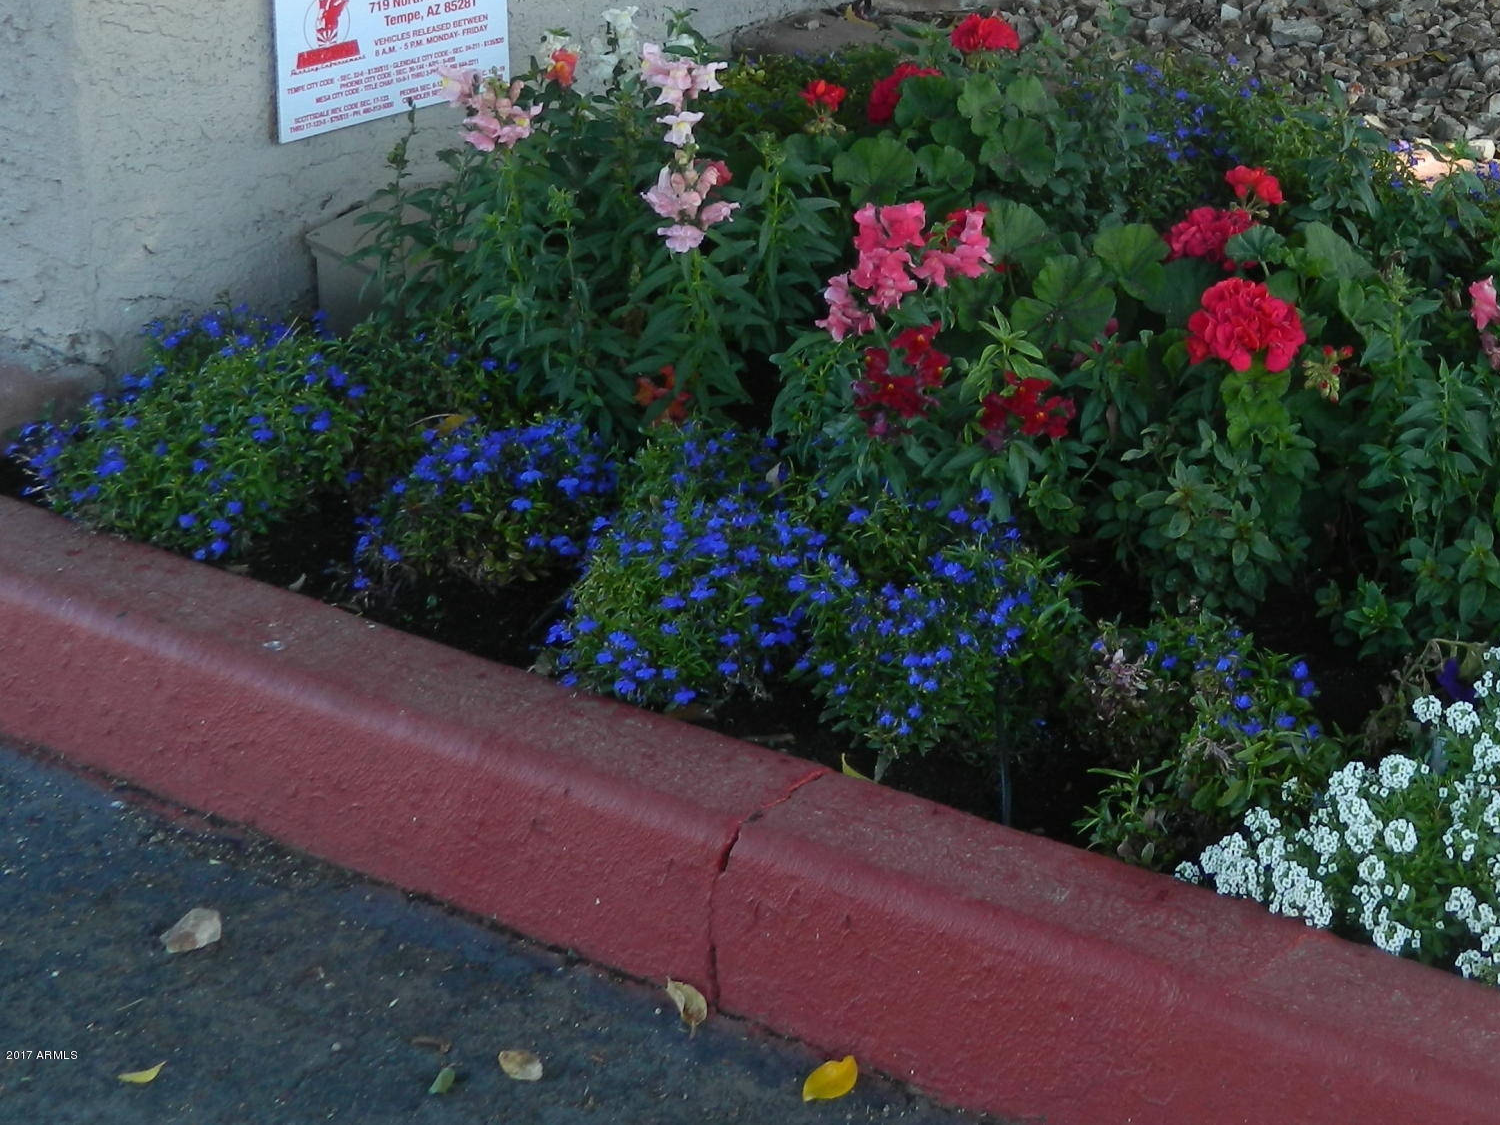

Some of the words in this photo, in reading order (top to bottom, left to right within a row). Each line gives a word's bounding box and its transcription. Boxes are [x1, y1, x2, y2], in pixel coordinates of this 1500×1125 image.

[369, 0, 389, 13] 719
[384, 10, 424, 26] Tempe,
[427, 3, 441, 17] AZ
[374, 31, 411, 46] VEHICLES
[412, 22, 451, 37] RELEASED
[453, 14, 488, 28] BETWEEN
[404, 43, 409, 51] 5
[462, 24, 488, 36] FRIDAY
[306, 82, 319, 91] CITY
[421, 53, 433, 62] CITY
[364, 76, 376, 84] CITY
[332, 92, 344, 100] CITY
